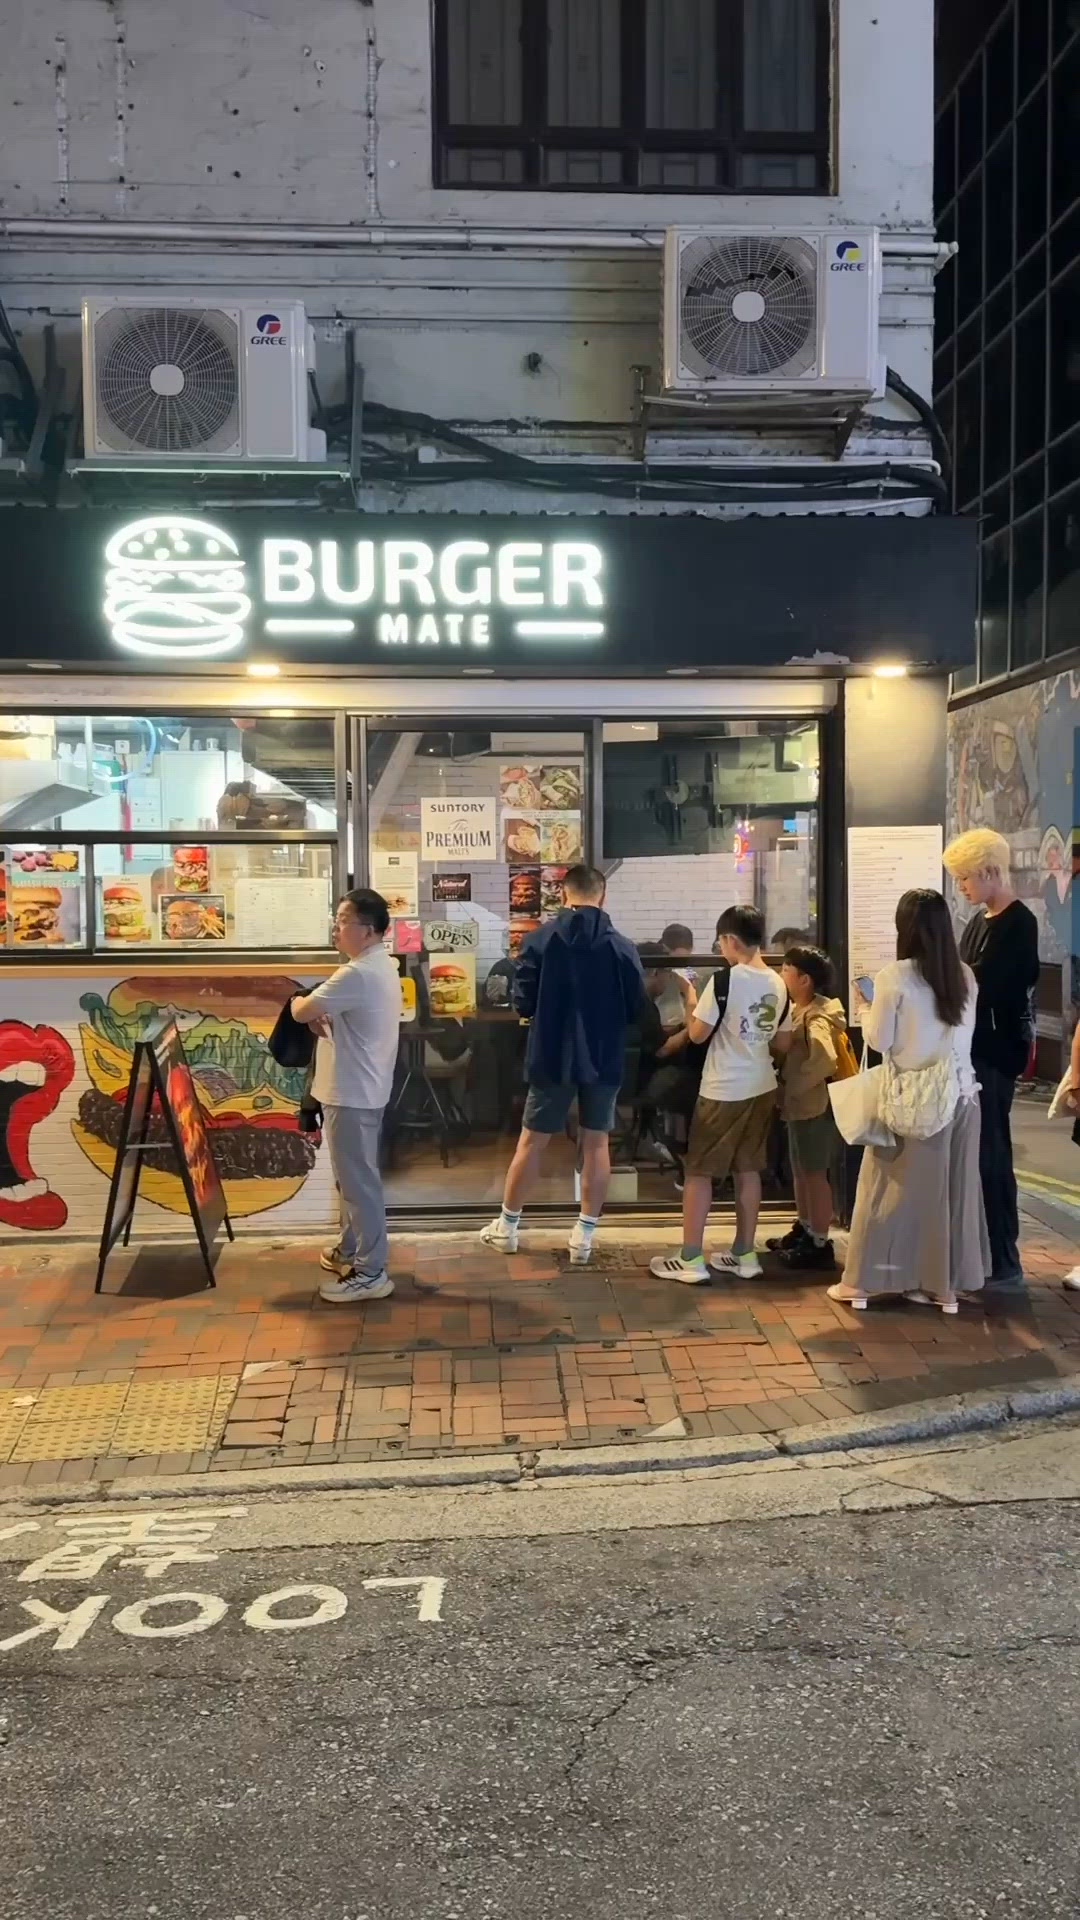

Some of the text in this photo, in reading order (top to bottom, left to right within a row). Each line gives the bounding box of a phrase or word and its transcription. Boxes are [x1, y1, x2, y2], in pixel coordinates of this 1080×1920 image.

[831, 262, 865, 272] GREE
[251, 335, 287, 346] GREE
[263, 538, 604, 605] BURGER
[378, 613, 490, 644] MATE
[430, 803, 486, 813] SUNTORY
[448, 818, 469, 832] The
[426, 830, 491, 848] PREMIUM
[431, 928, 473, 946] OPEN
[0, 1506, 249, 1582] 望
[0, 1576, 448, 1651] LOOK
